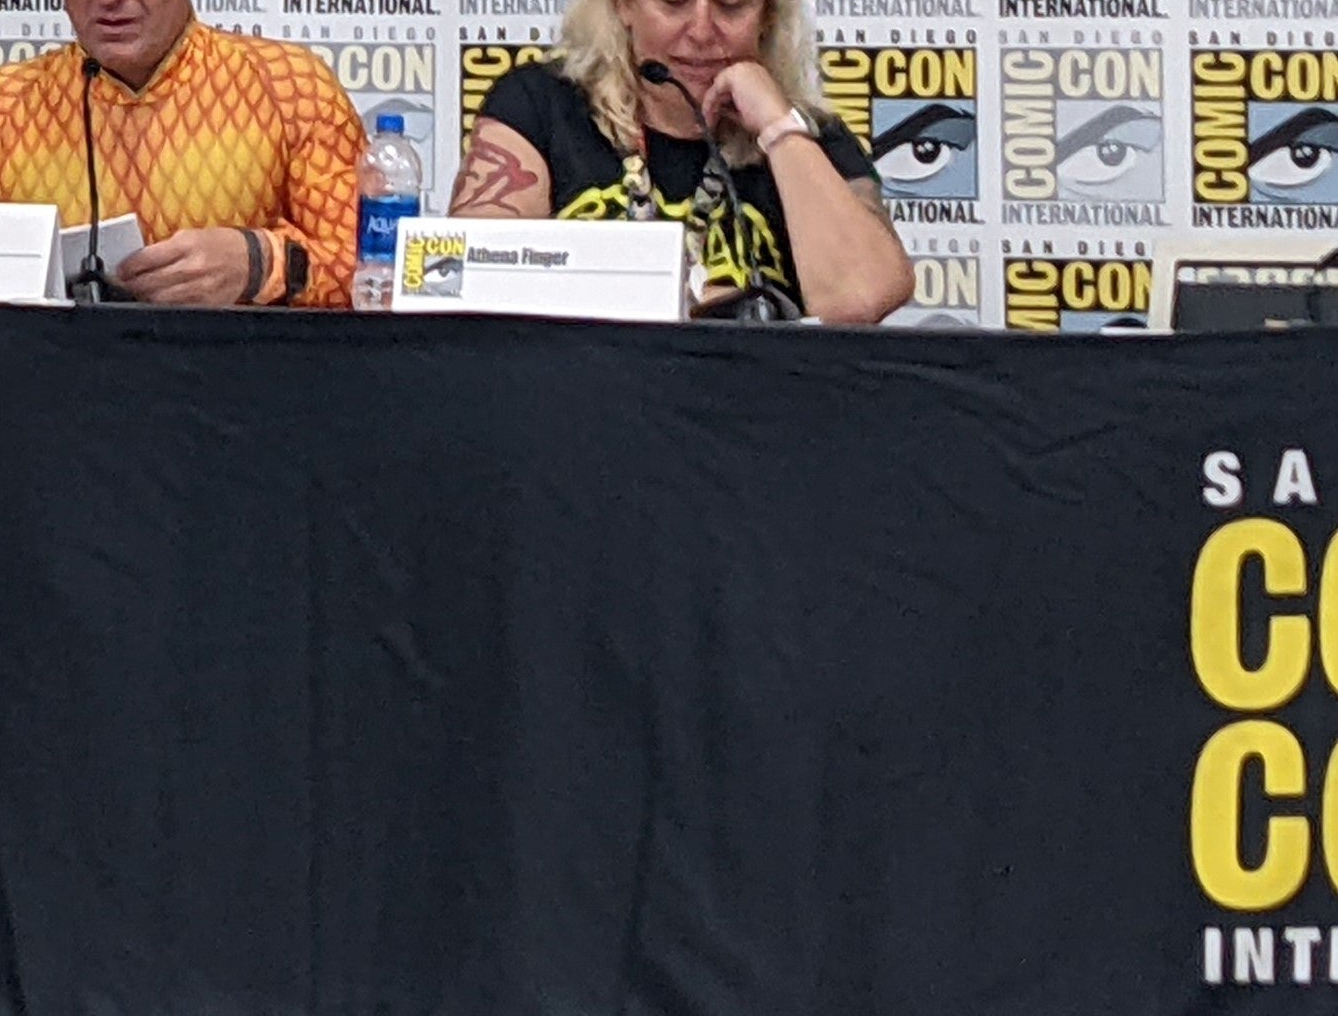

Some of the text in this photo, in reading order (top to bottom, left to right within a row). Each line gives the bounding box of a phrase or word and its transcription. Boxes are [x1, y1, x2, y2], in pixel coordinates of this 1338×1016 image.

[425, 237, 464, 256] CON
[466, 246, 569, 268] Athena Finger
[1202, 450, 1320, 504] SA
